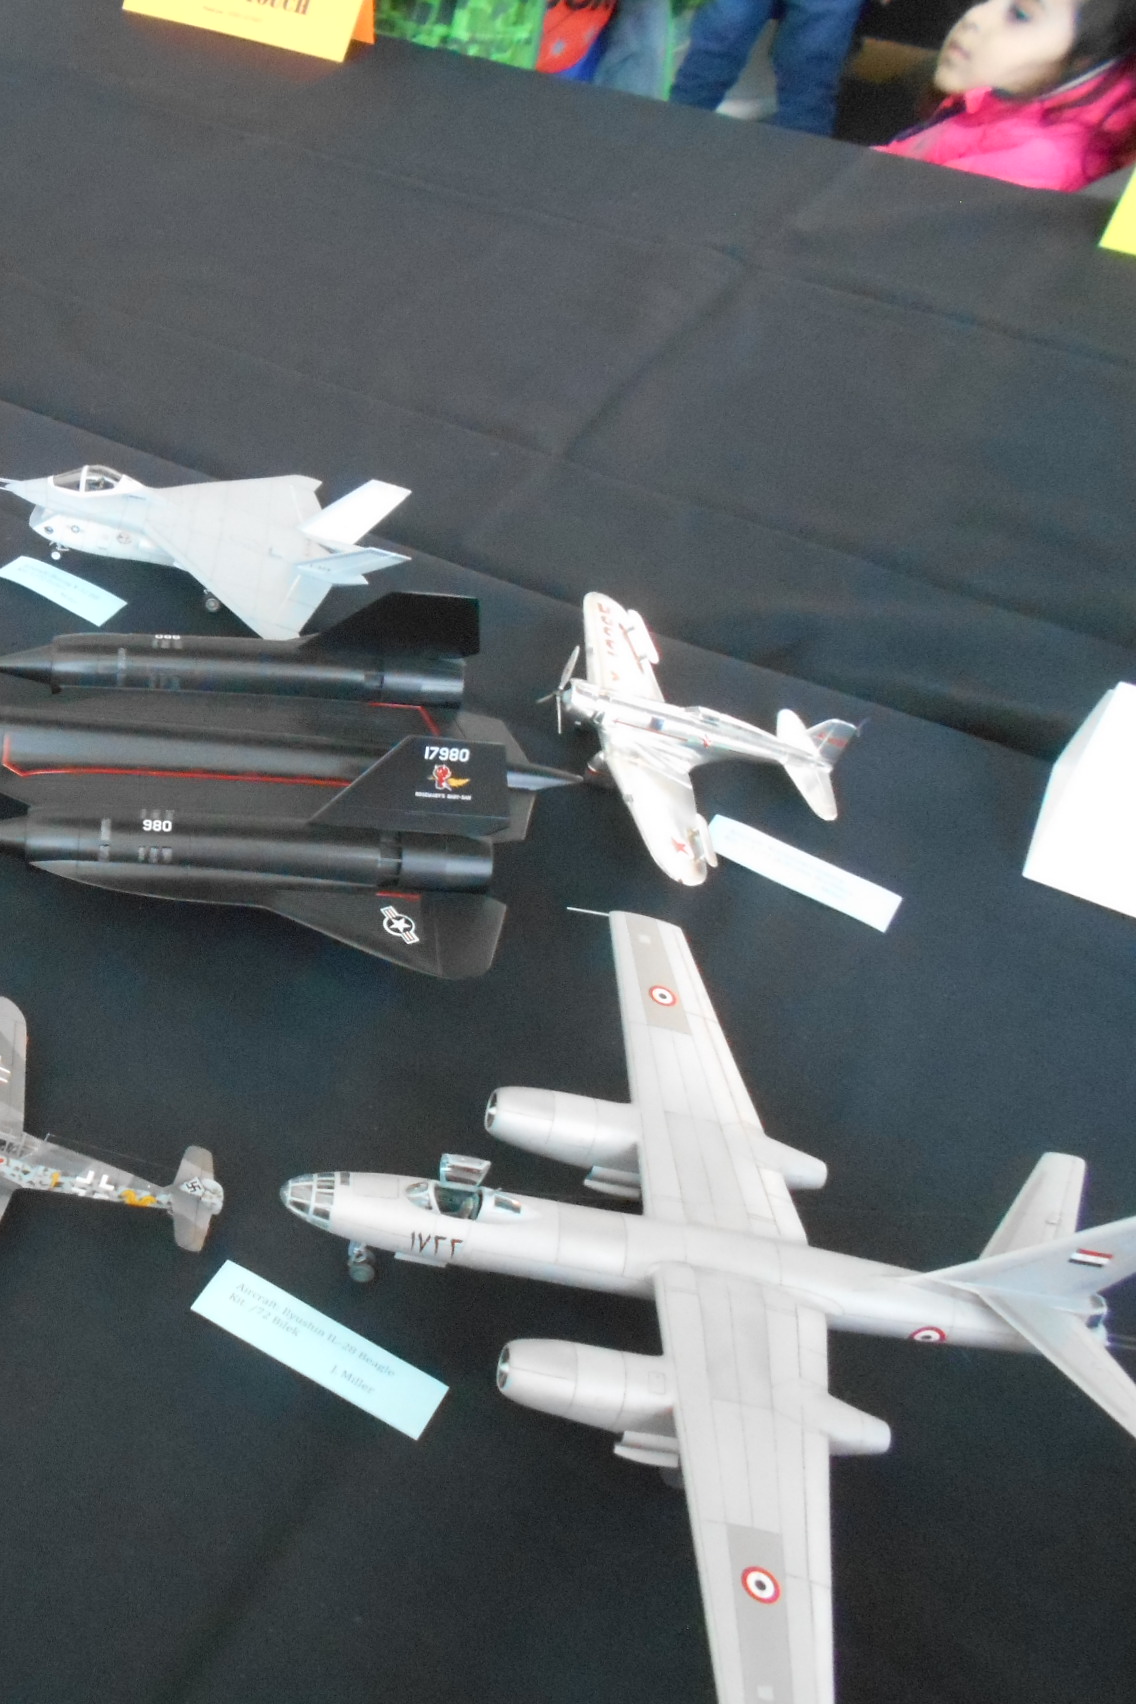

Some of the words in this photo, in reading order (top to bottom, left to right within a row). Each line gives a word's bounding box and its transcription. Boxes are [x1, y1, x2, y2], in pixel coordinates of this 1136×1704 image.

[424, 746, 470, 762] 17980
[142, 819, 172, 832] 980
[358, 1351, 396, 1378] Beagle
[340, 1369, 376, 1395] Miller
